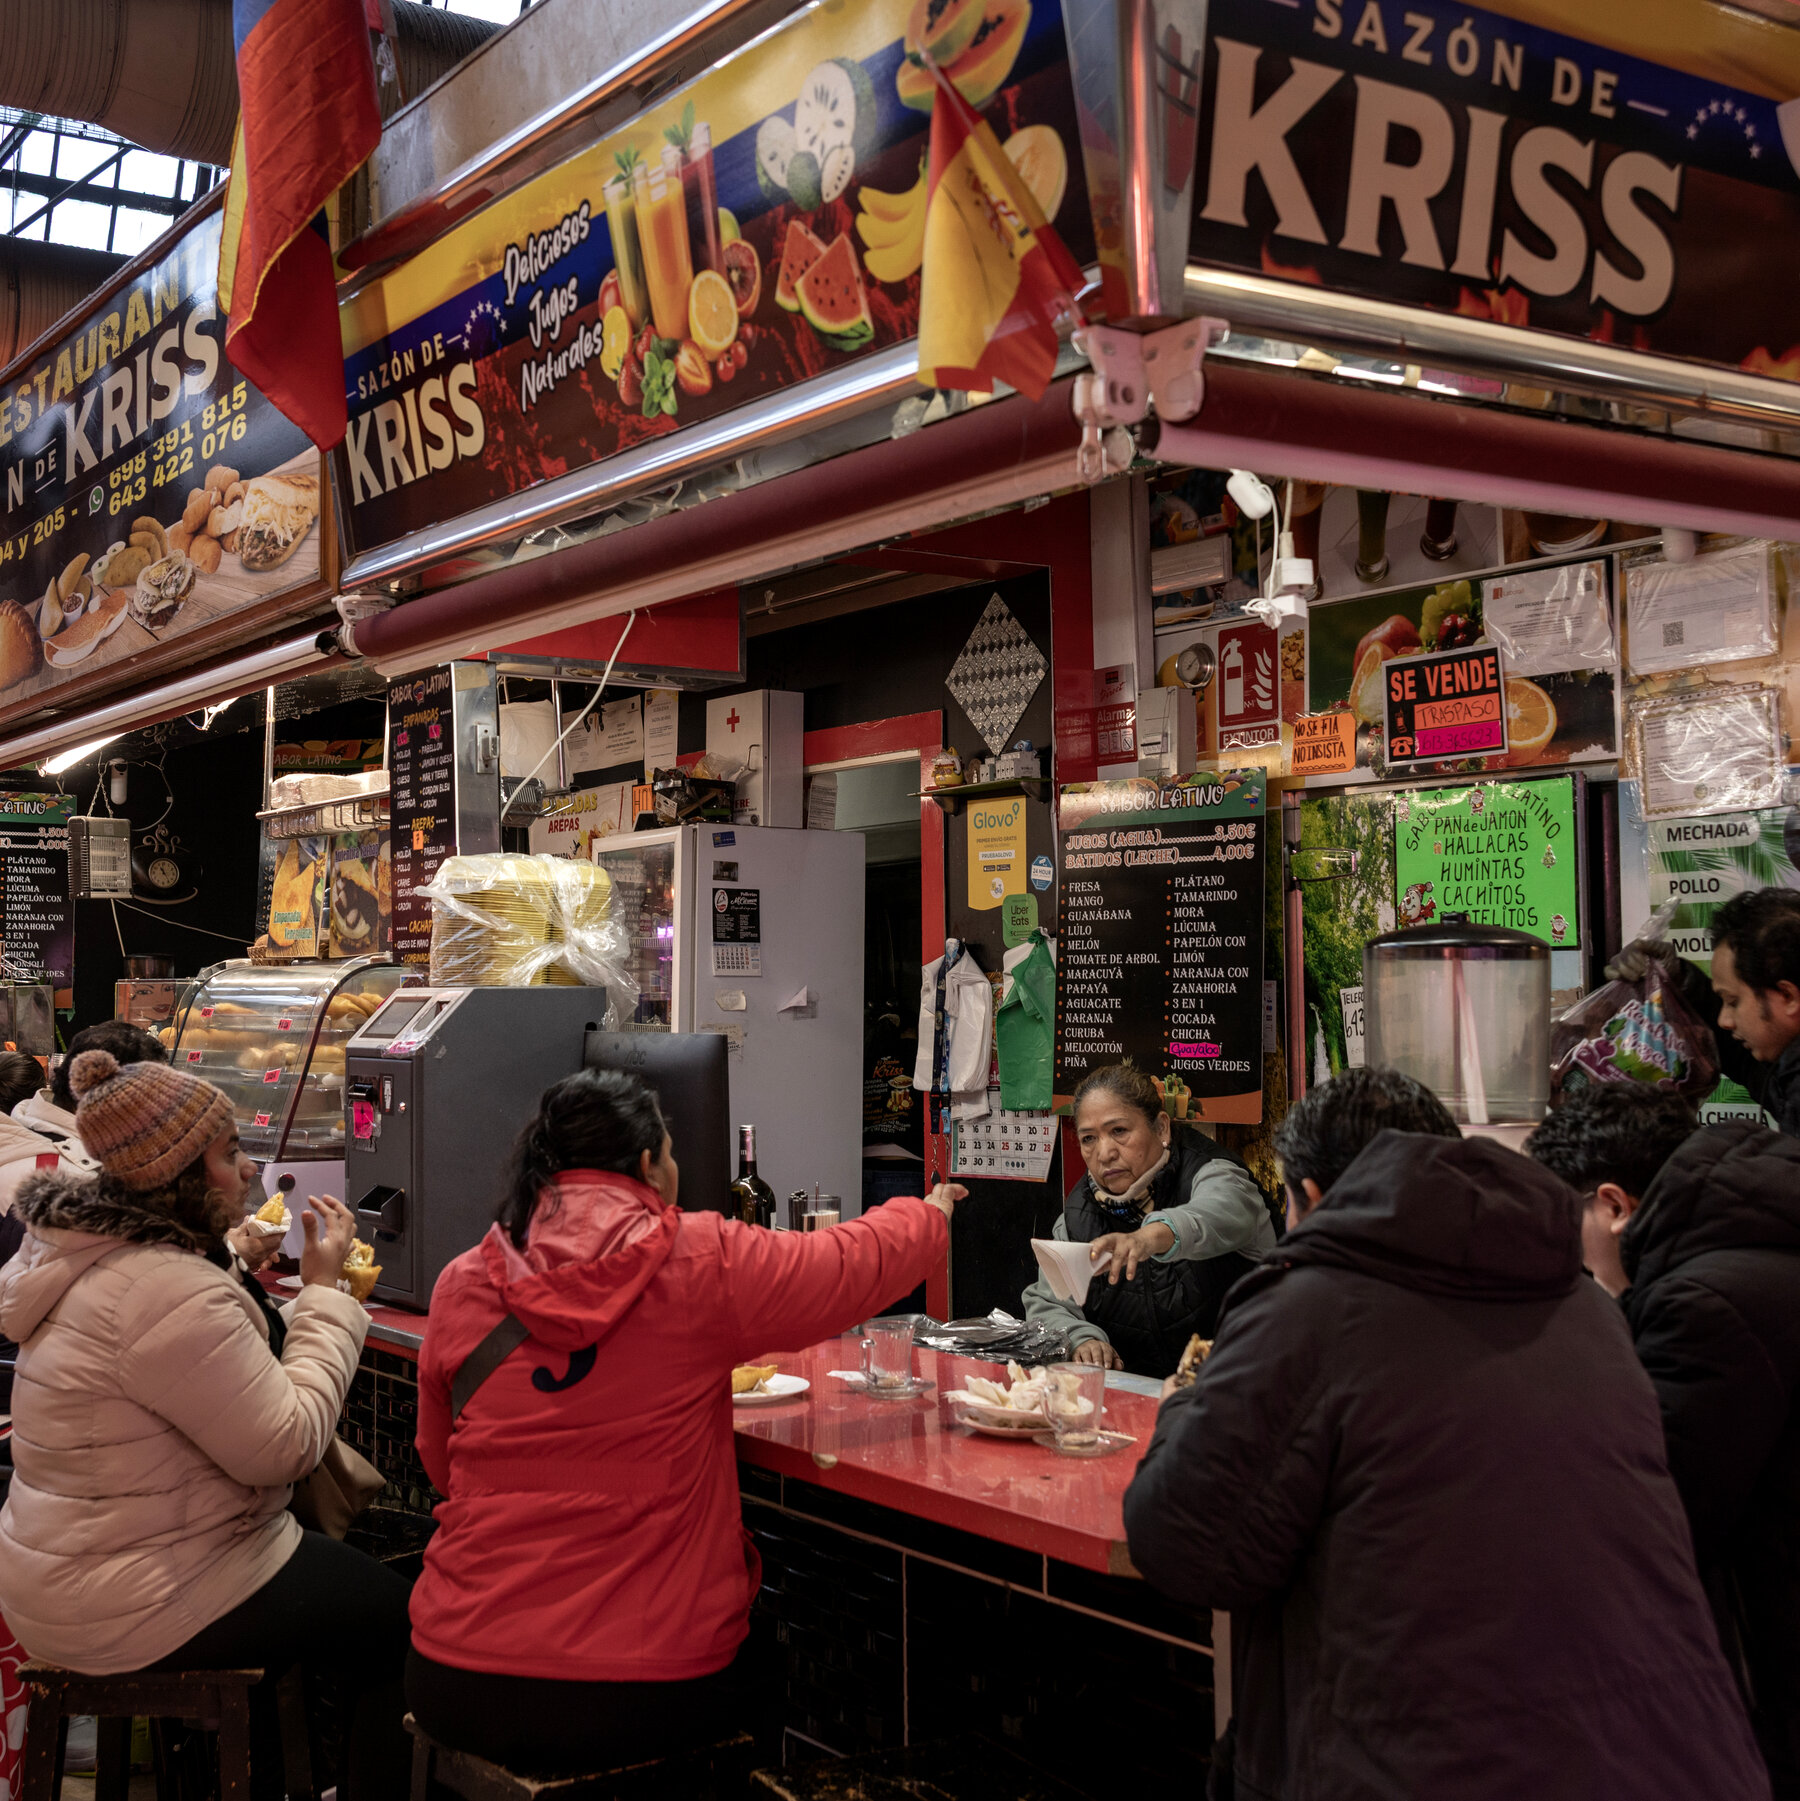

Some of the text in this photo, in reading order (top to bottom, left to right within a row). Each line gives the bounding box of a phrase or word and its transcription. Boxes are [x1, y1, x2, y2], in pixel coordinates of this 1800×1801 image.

[1312, 0, 1618, 120] SAZÓN DE
[1200, 36, 1683, 318] KRISS
[503, 200, 591, 306] Deliciosos
[528, 276, 578, 348] Jugos
[358, 333, 445, 400] SAZÓN DE
[521, 321, 603, 413] Naturales
[35, 449, 57, 481] DE
[64, 298, 219, 485] KRISS
[109, 381, 247, 490] 698 391 815
[346, 359, 485, 506] KRISS
[109, 413, 247, 516] 643 422 076
[19, 506, 65, 560] y 205
[1390, 655, 1498, 702] SE VENDE
[390, 684, 413, 705] SABOR
[425, 671, 450, 695] LATINO
[403, 707, 439, 728] EMPANADAS
[1418, 699, 1494, 728] TRASPASO
[1294, 716, 1339, 737] NO SE FIA
[1223, 727, 1275, 746] EXTINTOR
[307, 754, 342, 766] LATINO
[395, 749, 411, 760] MOLIDA
[1294, 747, 1306, 764] NO
[396, 762, 410, 773] POLLO
[396, 775, 410, 785] QUESO
[396, 789, 411, 799] CARNE
[1100, 784, 1226, 814] SABOR LATINO
[397, 798, 416, 810] MECHADA
[411, 816, 435, 831] AREPAS
[548, 817, 579, 834] AREPAS
[973, 812, 1014, 829] Glovo
[1434, 810, 1527, 835] PAN de JAMON
[1065, 823, 1256, 850] JUGOS (AGUA) 3,50€
[1667, 822, 1750, 842] MECHADA
[1444, 832, 1529, 856] HALLACAS
[7, 855, 46, 865] PLÁTANO
[1065, 844, 1255, 869] BATIDOS (LECHE) 4,00€
[7, 866, 56, 875] TAMARINDO
[397, 860, 438, 873] POLLO QUESO
[6, 875, 31, 883] MORA
[1069, 874, 1225, 893] FRESA PLÁTANO
[1669, 878, 1720, 895] POLLO
[6, 885, 40, 893] LÚCUMA
[6, 893, 44, 902] PAPELÓN
[1068, 890, 1238, 907] MANGO TAMARINDO
[6, 903, 31, 911] LIMÓN
[1010, 905, 1028, 915] Uber
[1068, 906, 1204, 922] GUANÁBANA MORA
[5, 913, 46, 921] NARANJA
[1011, 916, 1029, 926] Eats
[5, 923, 55, 931] ZANAHORIA
[409, 920, 433, 934] CACHAP
[1067, 920, 1216, 936] LÚLO LÚCUMA
[5, 941, 39, 949] COCADA
[397, 941, 410, 950] QUESO
[1067, 934, 1246, 950] MELÓN PAPELÓN CON
[1067, 953, 1160, 965] TOMATE DE ARBOL
[1173, 950, 1205, 963] LIMÓN
[1172, 967, 1225, 979] NARANJA
[1227, 967, 1249, 978] CON
[1066, 981, 1237, 994] PAPAYA ZANAHORIA
[1066, 998, 1204, 1009] AGUACATE 3 EN 1
[1065, 1013, 1216, 1025] NARANJA COCADA
[1344, 1008, 1365, 1038] 643
[1065, 1028, 1211, 1040] CURUBA CHICHA
[1064, 1041, 1122, 1053] MELOCOTÓN
[1064, 1054, 1250, 1072] PIÑA JUGOS VERDES
[1699, 1111, 1769, 1128] LCHICHA
[958, 1125, 1049, 1135] 15 16 17 18 19 20 21
[959, 1141, 1051, 1152] 22 23 24 25 26 27 28
[959, 1157, 995, 1166] 29 30 31
